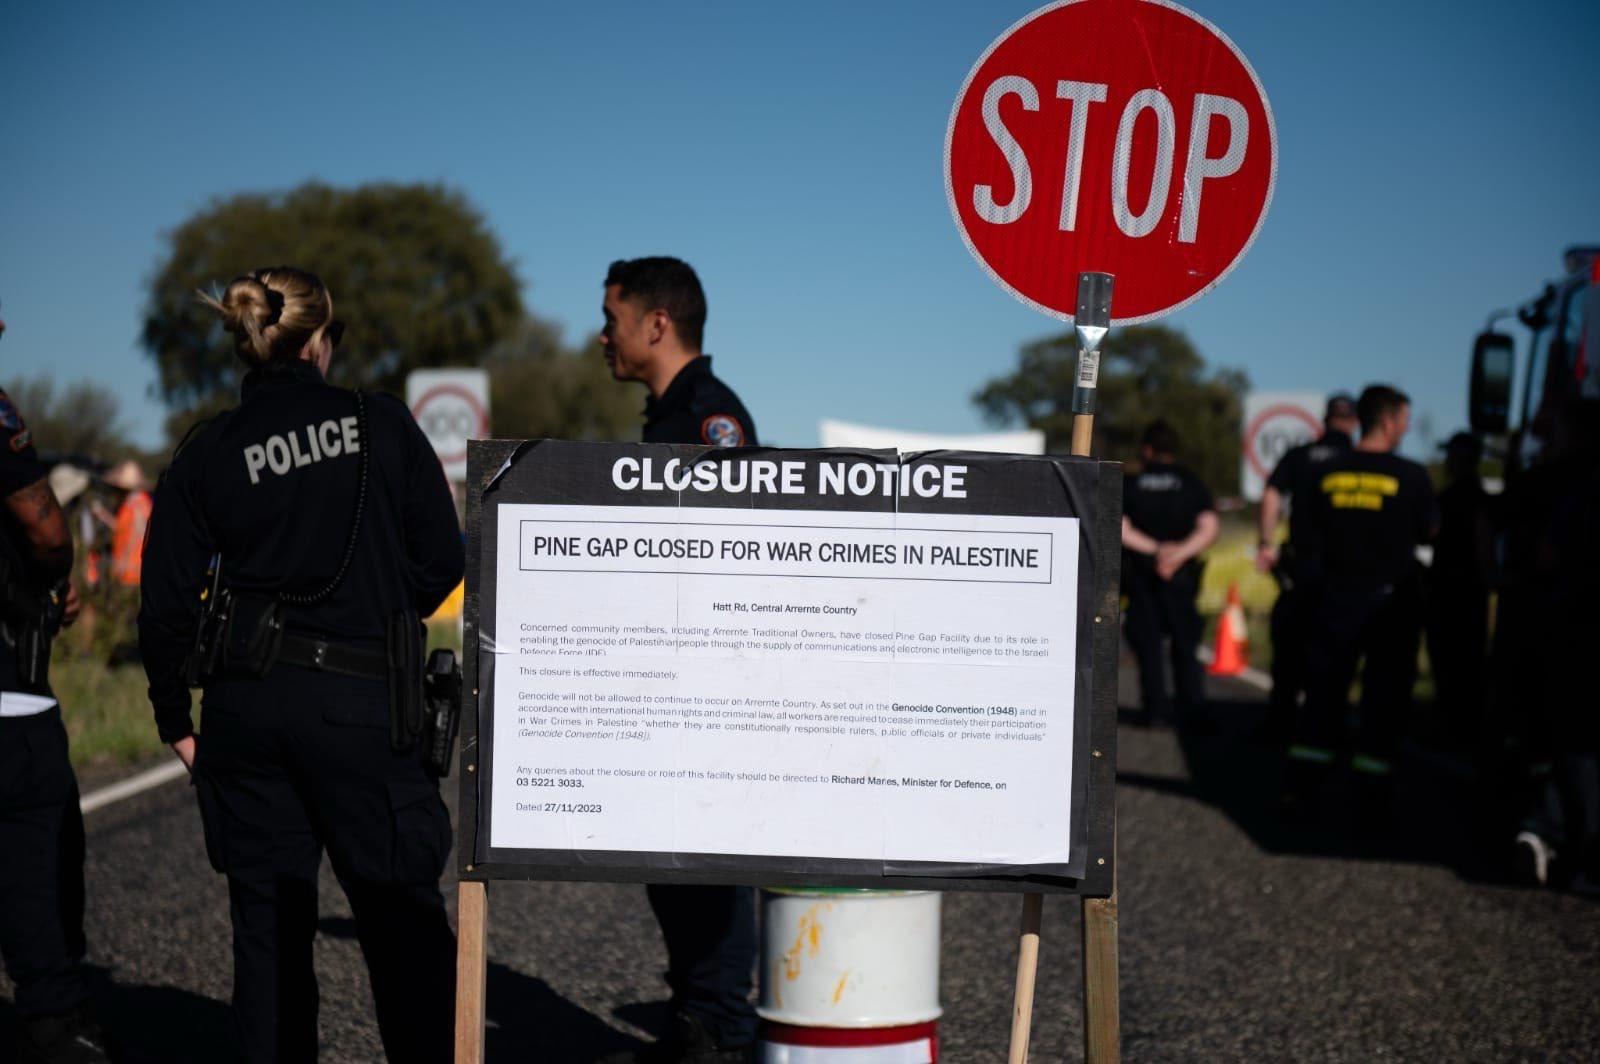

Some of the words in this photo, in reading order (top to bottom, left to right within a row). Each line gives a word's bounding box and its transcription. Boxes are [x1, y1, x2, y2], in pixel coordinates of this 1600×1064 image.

[972, 75, 1249, 244] STOP
[243, 416, 361, 485] POLICE
[611, 456, 806, 495] CLOSURE
[818, 460, 968, 499] NOTICE
[534, 536, 581, 557] PINE
[587, 537, 628, 558] GAP
[634, 538, 714, 560] CLOSED
[720, 540, 761, 561] FOR
[767, 541, 812, 563] WAR
[818, 542, 897, 564] CRIMES
[904, 545, 923, 565] IN
[930, 546, 1039, 569] PALESTINE
[712, 602, 732, 612] Hatt
[734, 603, 749, 613] Rd,
[751, 604, 783, 613] Central
[785, 604, 821, 614] Arrernte
[822, 605, 858, 616] Country
[520, 623, 568, 632] Concerned
[571, 624, 620, 635] community
[623, 626, 668, 635] members,
[712, 627, 749, 636] Arrernte
[752, 628, 798, 638] Traditional
[801, 629, 837, 639] Owners,
[840, 630, 861, 640] have
[864, 632, 893, 640] closed
[896, 632, 915, 641] Pine
[918, 632, 937, 643] Gap
[940, 633, 971, 644] Facility
[973, 634, 991, 644] due
[994, 635, 1003, 644] to
[1006, 635, 1017, 644] its
[1020, 636, 1038, 645] role
[1040, 636, 1049, 645] in
[520, 636, 558, 646] enabling
[560, 636, 575, 645] the
[576, 637, 617, 647] genocide
[618, 637, 627, 646] of
[678, 640, 709, 649] people
[710, 640, 744, 650] through
[746, 640, 761, 649] the
[762, 641, 792, 651] supply
[793, 642, 803, 650] of
[804, 642, 877, 652] communications
[897, 644, 940, 654] electronic
[942, 645, 992, 656] intelligence
[994, 647, 1003, 656] to
[1005, 647, 1020, 656] the
[1022, 647, 1049, 657] Israeli
[519, 666, 537, 676] This
[539, 668, 571, 677] closure
[574, 668, 581, 676] is
[582, 668, 621, 678] effective
[622, 670, 678, 680] immediately.
[518, 692, 560, 701] Genocide
[562, 692, 576, 701] will
[578, 694, 592, 702] not
[594, 693, 606, 702] be
[608, 694, 642, 703] allowed
[643, 695, 652, 703] to
[654, 695, 692, 704] continue
[694, 696, 703, 705] to
[732, 698, 743, 706] on
[744, 698, 780, 708] Arrernte
[782, 699, 818, 710] Country.
[820, 700, 832, 709] As
[832, 702, 847, 710] set
[849, 702, 864, 710] out
[866, 702, 874, 710] in
[876, 702, 889, 711] the
[892, 703, 934, 713] Genocide
[935, 704, 985, 715] Convention
[986, 706, 1018, 717] (1948)
[1019, 708, 1037, 716] and
[1039, 708, 1047, 717] in
[518, 705, 569, 714] accordance
[570, 706, 589, 714] with
[590, 706, 645, 716] international
[646, 707, 677, 716] human
[678, 708, 703, 718] rights
[704, 710, 721, 718] and
[722, 710, 757, 719] criminal
[758, 711, 776, 720] law,
[776, 712, 787, 720] all
[788, 712, 823, 721] workers
[824, 714, 839, 722] are
[840, 714, 877, 724] required
[878, 715, 887, 723] to
[887, 716, 914, 724] cease
[915, 716, 969, 727] immediately
[970, 718, 990, 727] their
[991, 719, 1047, 729] participation
[518, 717, 526, 725] in
[530, 717, 547, 725] War
[550, 717, 581, 726] Crimes
[585, 718, 593, 726] in
[597, 718, 638, 728] Palestine
[684, 721, 703, 731] they
[706, 722, 721, 730] are
[724, 722, 791, 733] constitutionally
[794, 725, 846, 734] responsible
[849, 726, 877, 736] rulers,
[910, 728, 945, 738] officials
[961, 731, 991, 740] private
[518, 728, 563, 738] (Genocide
[564, 730, 614, 740] Convention
[516, 766, 533, 775] Any
[534, 766, 568, 776] queries
[568, 767, 595, 776] about
[597, 768, 612, 776] the
[613, 768, 646, 777] closure
[659, 770, 676, 778] role
[677, 770, 686, 778] of
[688, 770, 704, 779] this
[706, 770, 735, 781] facility
[736, 772, 767, 781] should
[768, 772, 780, 782] be
[782, 774, 818, 783] directed
[820, 775, 829, 783] to
[831, 775, 865, 785] Richard
[902, 778, 937, 788] Minister
[940, 779, 952, 788] for
[954, 780, 993, 790] Defence,
[995, 782, 1007, 790] on
[516, 778, 529, 787] 03
[531, 778, 555, 787] 5221
[558, 778, 585, 788] 3033.
[516, 802, 543, 811] Dated
[544, 803, 602, 814] 27/11/2023
